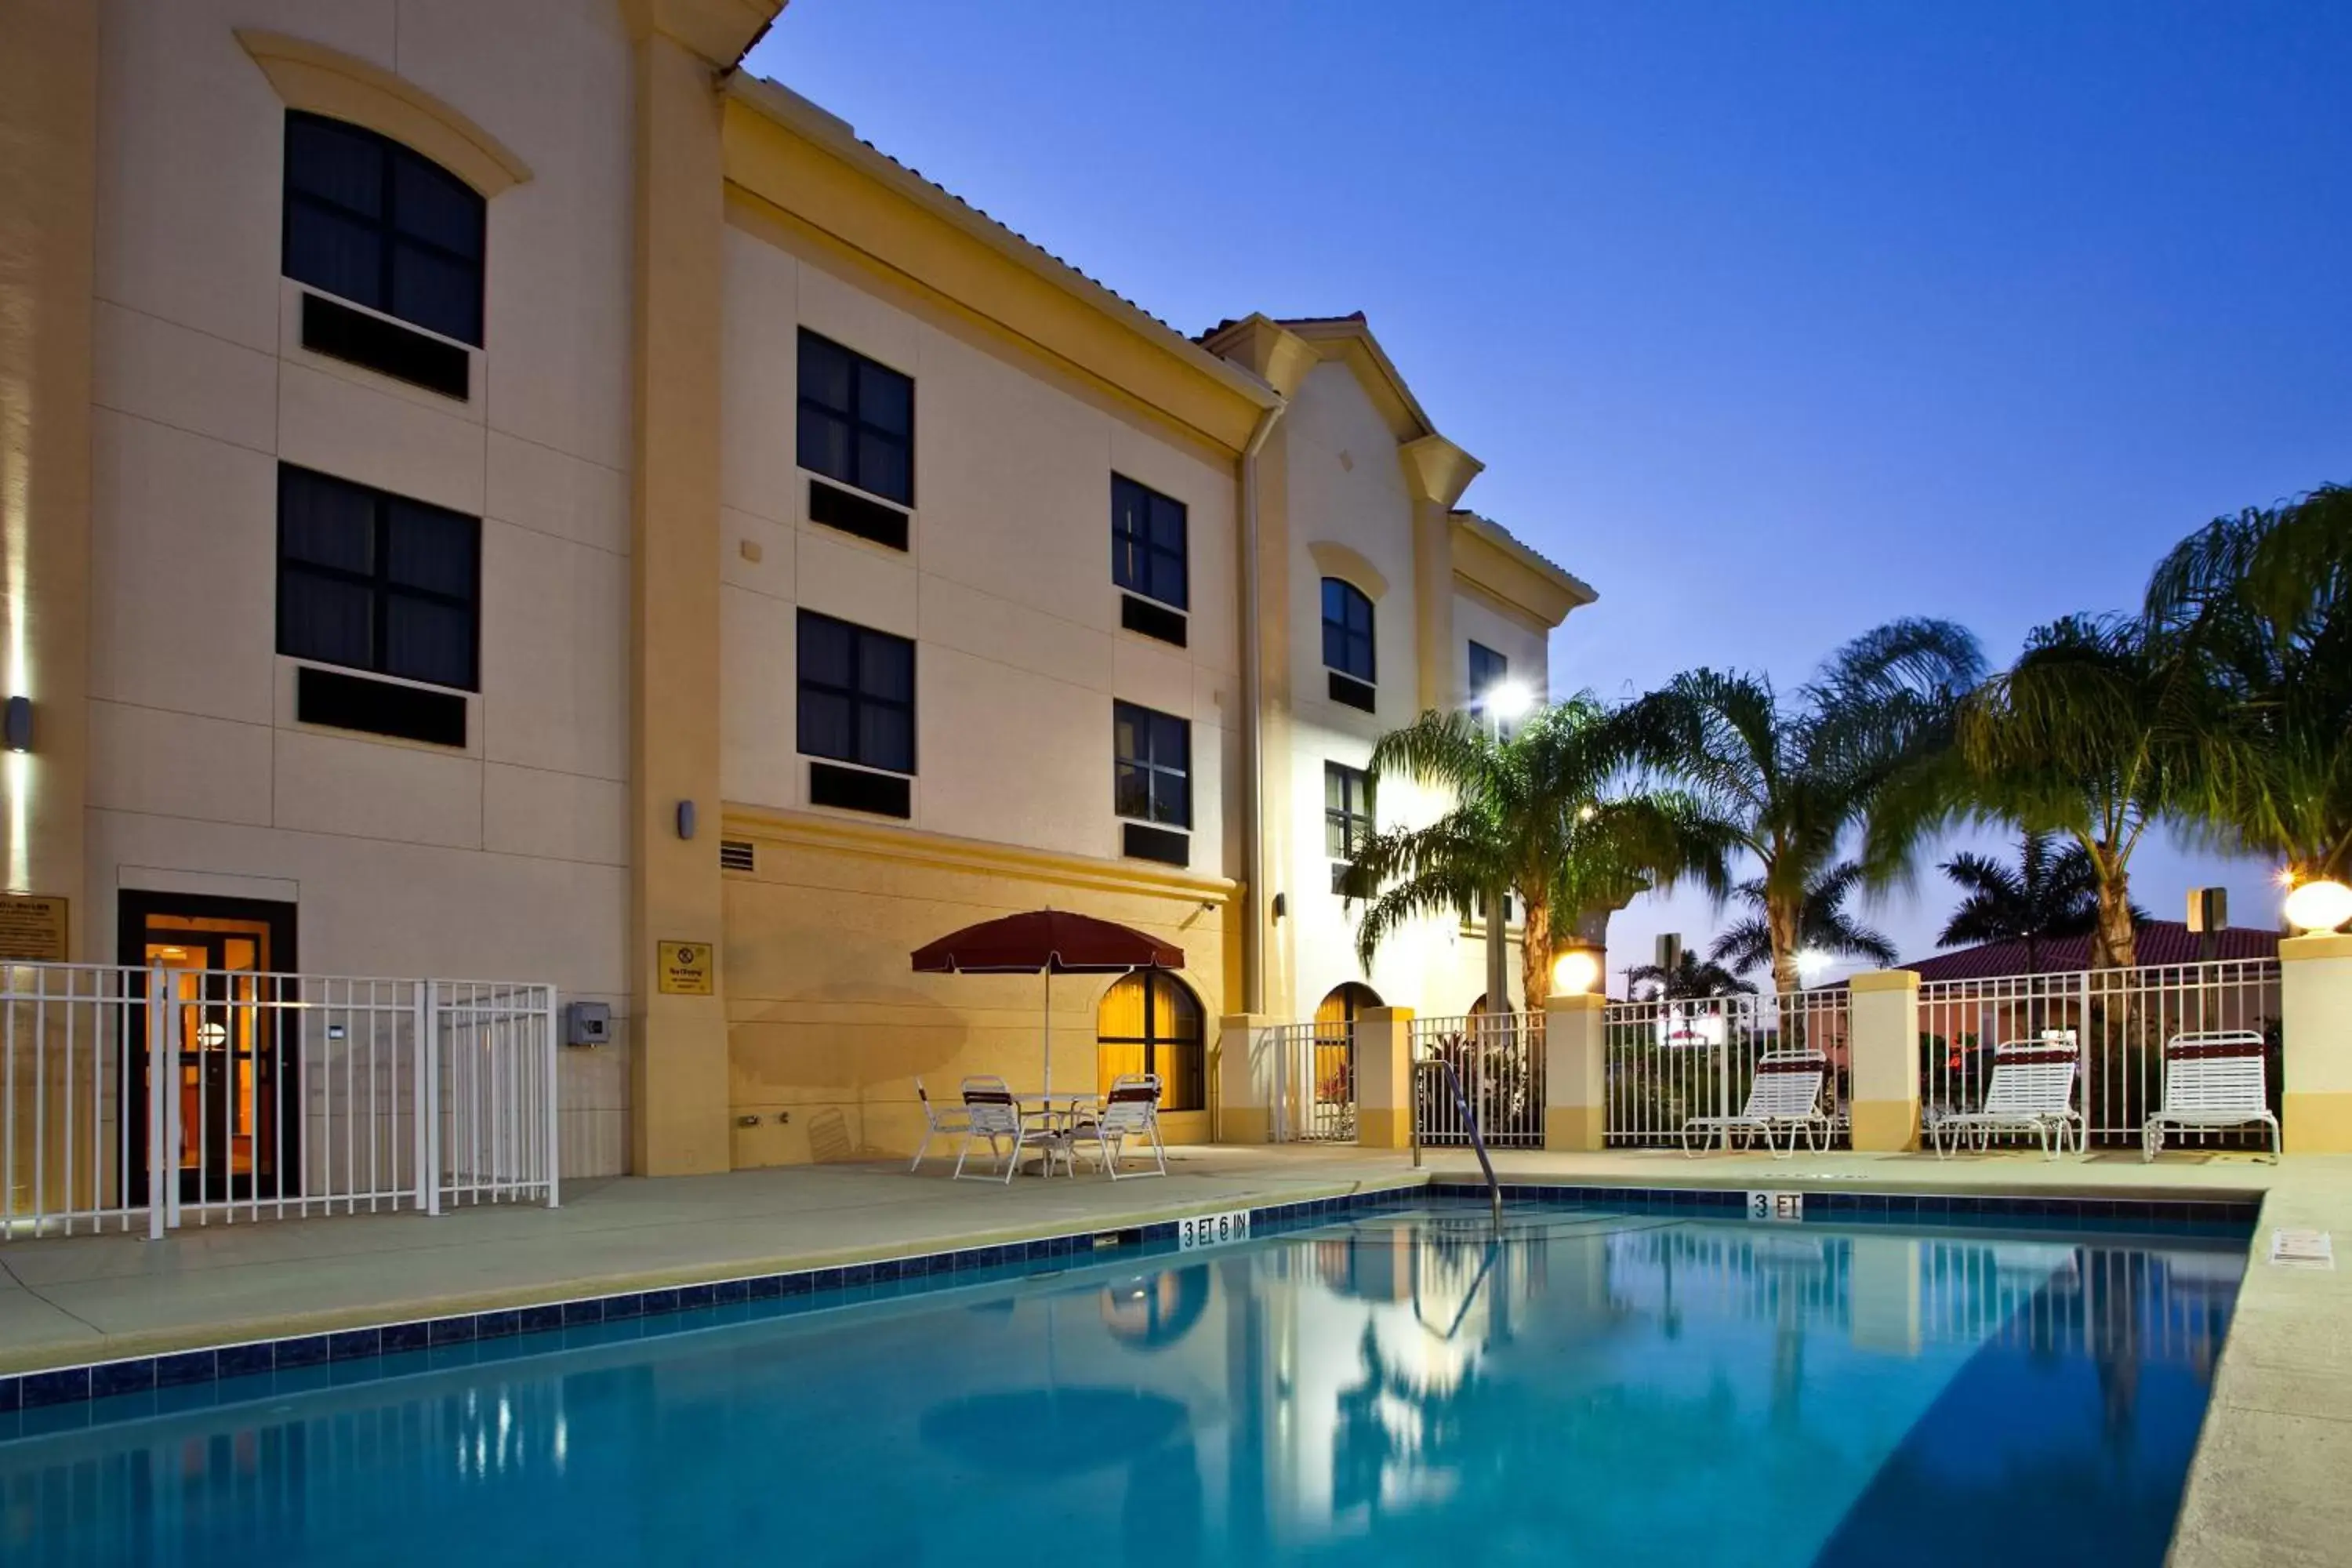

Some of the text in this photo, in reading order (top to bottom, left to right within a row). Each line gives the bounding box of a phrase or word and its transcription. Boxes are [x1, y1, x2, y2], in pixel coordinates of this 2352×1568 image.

[1755, 1194, 1768, 1215] 3
[1185, 1221, 1193, 1244] 3
[1219, 1216, 1229, 1239] 6
